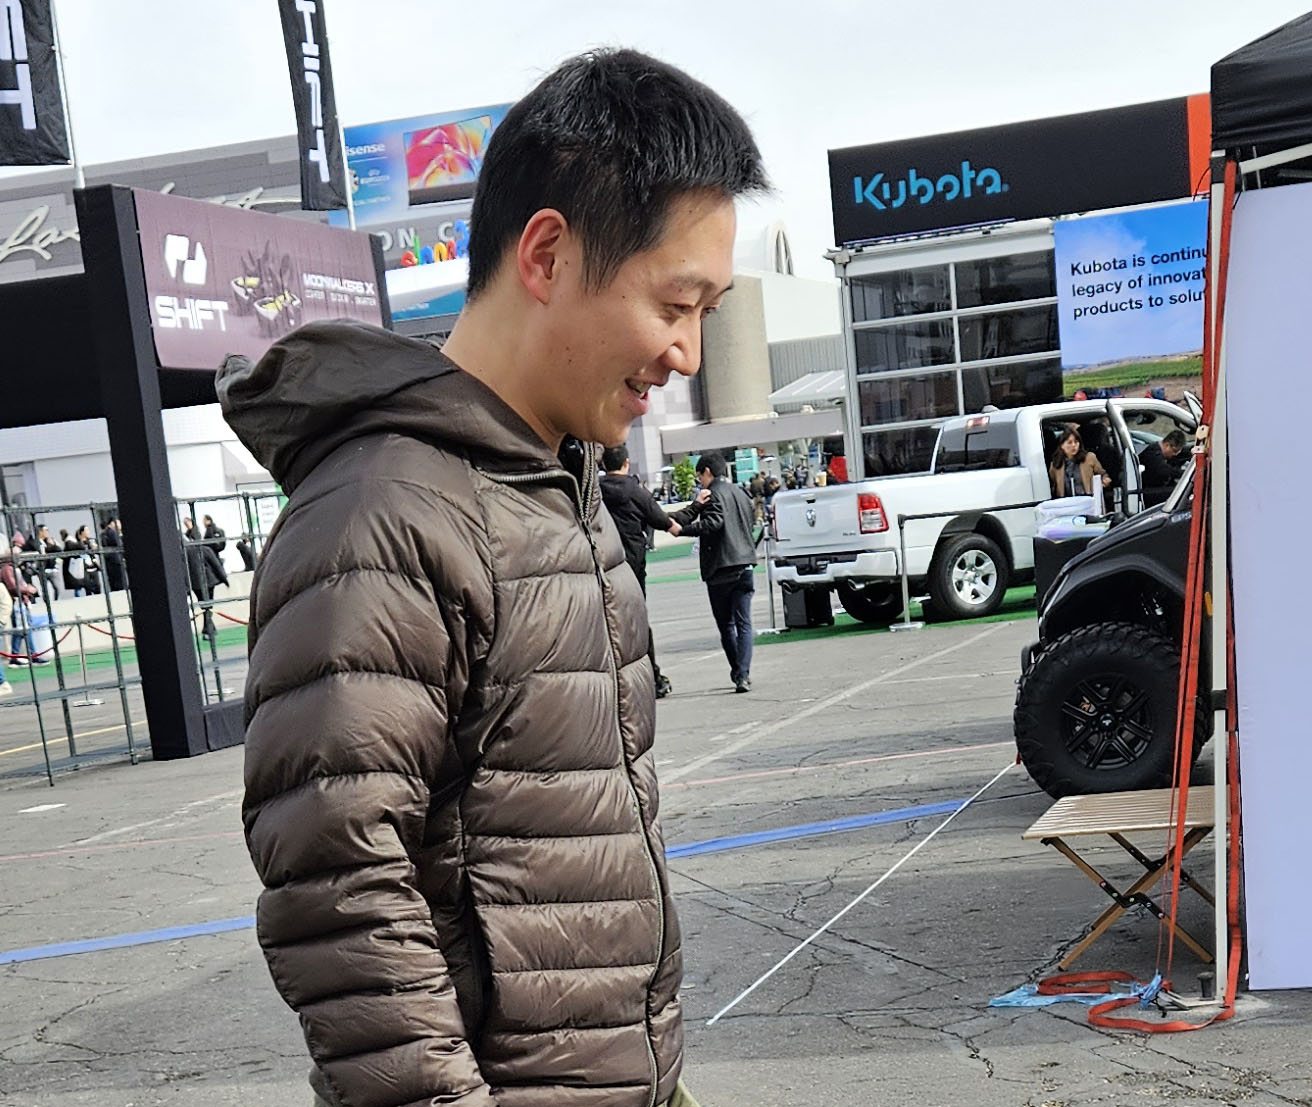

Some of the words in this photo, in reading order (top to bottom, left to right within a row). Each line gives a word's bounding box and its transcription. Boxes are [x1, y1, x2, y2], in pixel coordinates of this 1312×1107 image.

[853, 160, 1003, 211] Kubota
[1071, 256, 1128, 276] Kubota
[1132, 254, 1146, 268] is
[1072, 279, 1123, 298] legacy
[1128, 274, 1143, 289] of
[155, 295, 229, 332] SHIFT
[1073, 298, 1143, 320] products
[1149, 295, 1164, 308] to
